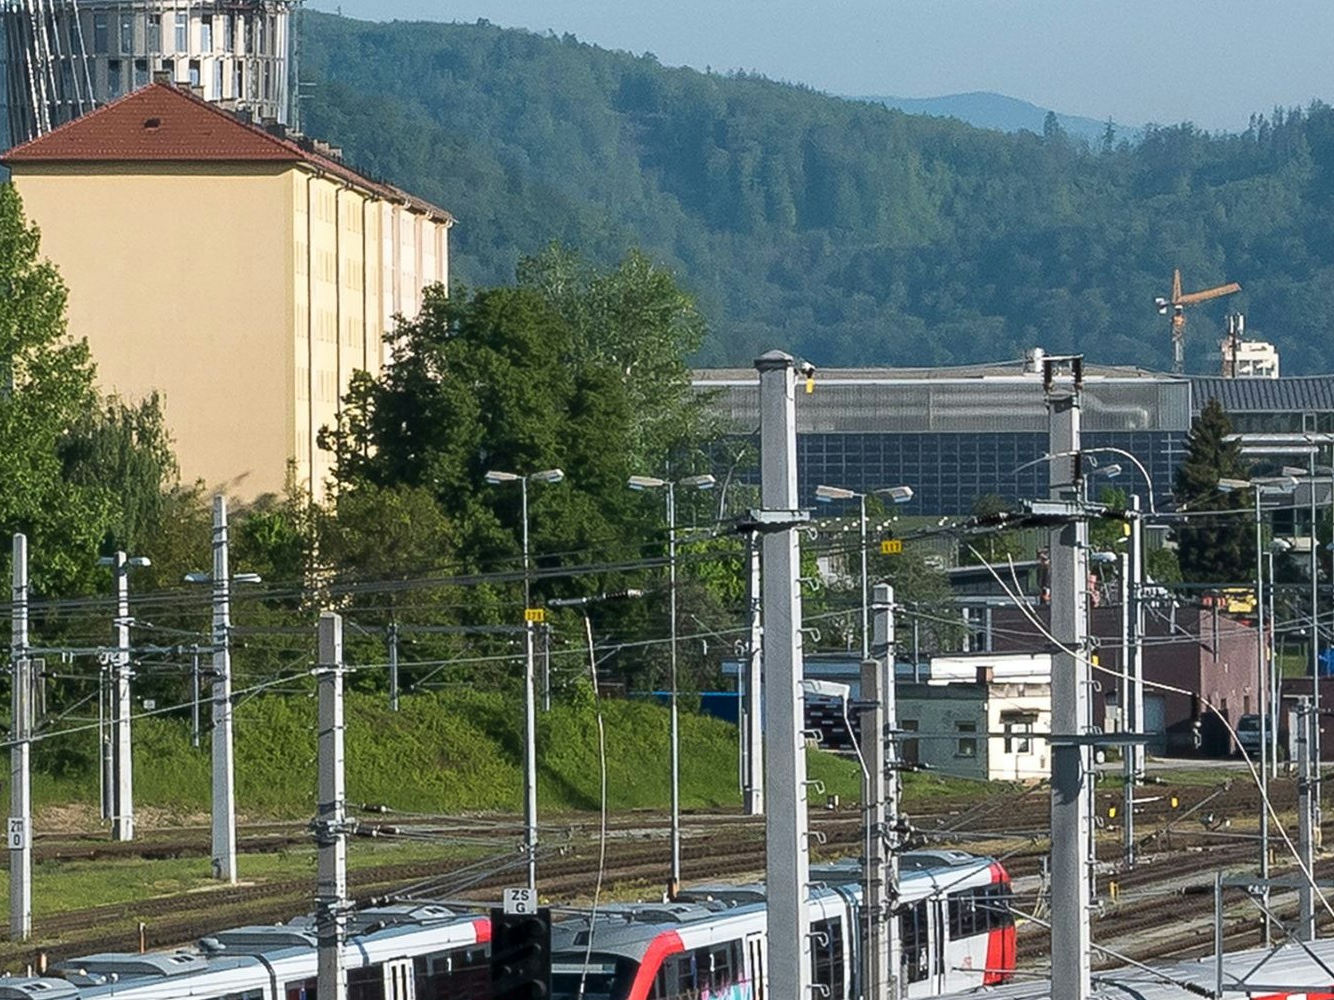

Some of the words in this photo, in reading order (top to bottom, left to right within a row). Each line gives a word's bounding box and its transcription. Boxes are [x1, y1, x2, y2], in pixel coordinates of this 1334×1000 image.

[13, 834, 21, 846] 0
[511, 890, 529, 901] ZS
[515, 902, 526, 913] G
